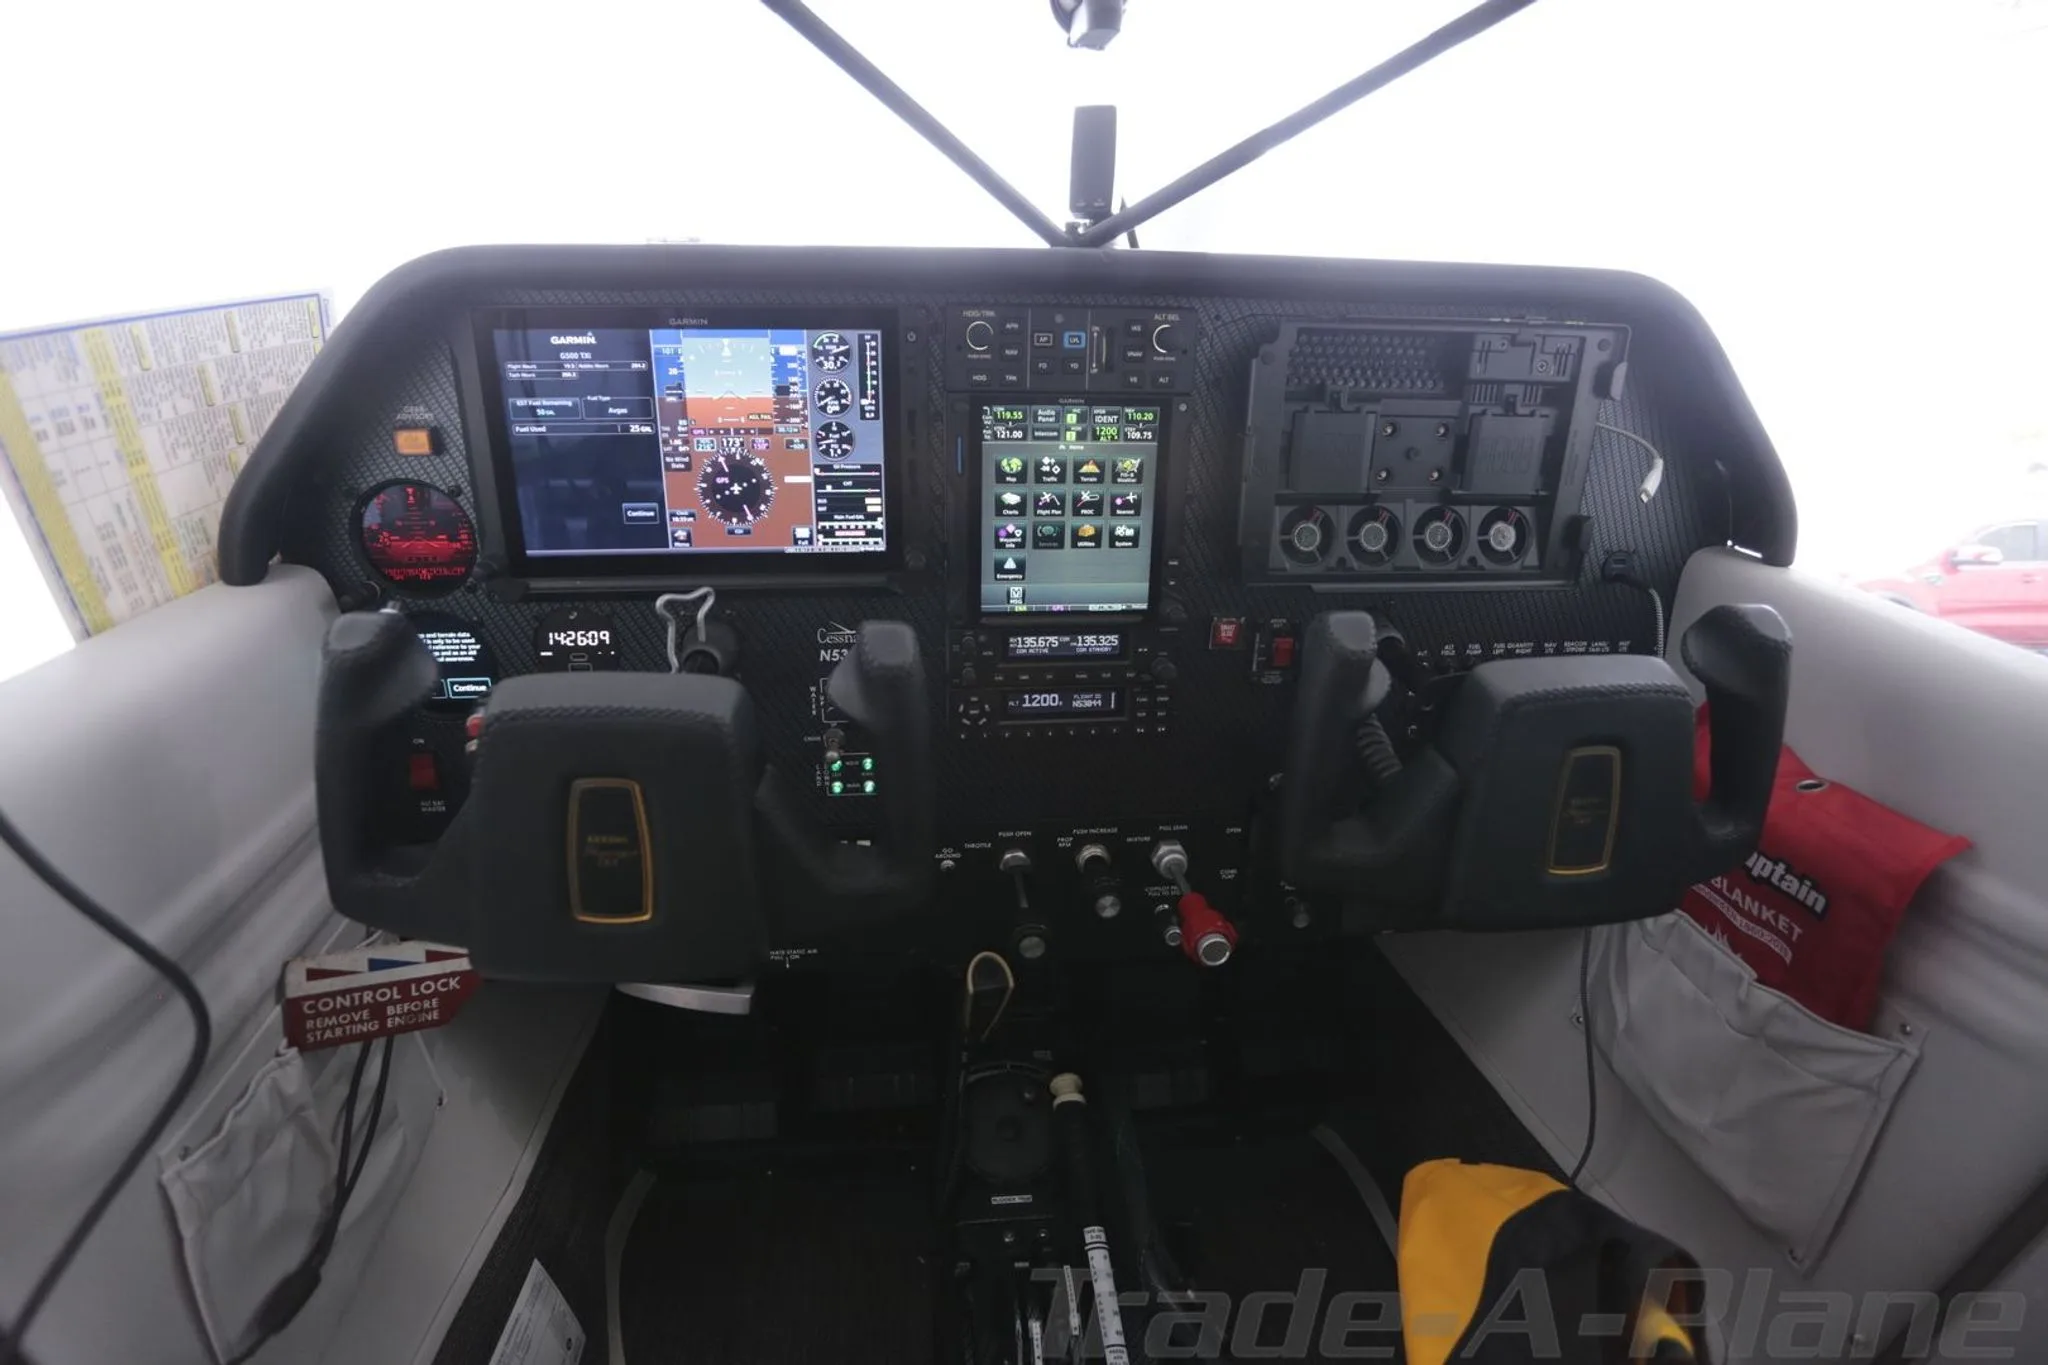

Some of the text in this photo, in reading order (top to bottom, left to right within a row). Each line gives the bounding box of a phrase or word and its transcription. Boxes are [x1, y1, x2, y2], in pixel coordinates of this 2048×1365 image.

[668, 317, 709, 325] GARMIN
[550, 335, 597, 344] GARMIN
[997, 411, 1023, 420] 119.55
[1094, 415, 1119, 424] IDENT
[1128, 412, 1154, 421] 110.20
[515, 425, 547, 433] Fuel Used
[629, 425, 642, 433] 25
[1095, 426, 1118, 436] 1200
[997, 430, 1023, 439] 121.00
[1127, 431, 1153, 440] 109.75
[548, 630, 611, 647] 142609
[1017, 636, 1059, 648] 135.675
[1077, 635, 1119, 647] 135.325
[1022, 693, 1059, 708] 1200
[1711, 876, 1803, 942] BLANKET
[303, 976, 462, 1015] CONTROL LOCK
[306, 998, 440, 1031] REMOVE BEFORE
[306, 1010, 440, 1044] STARTING ENGINE
